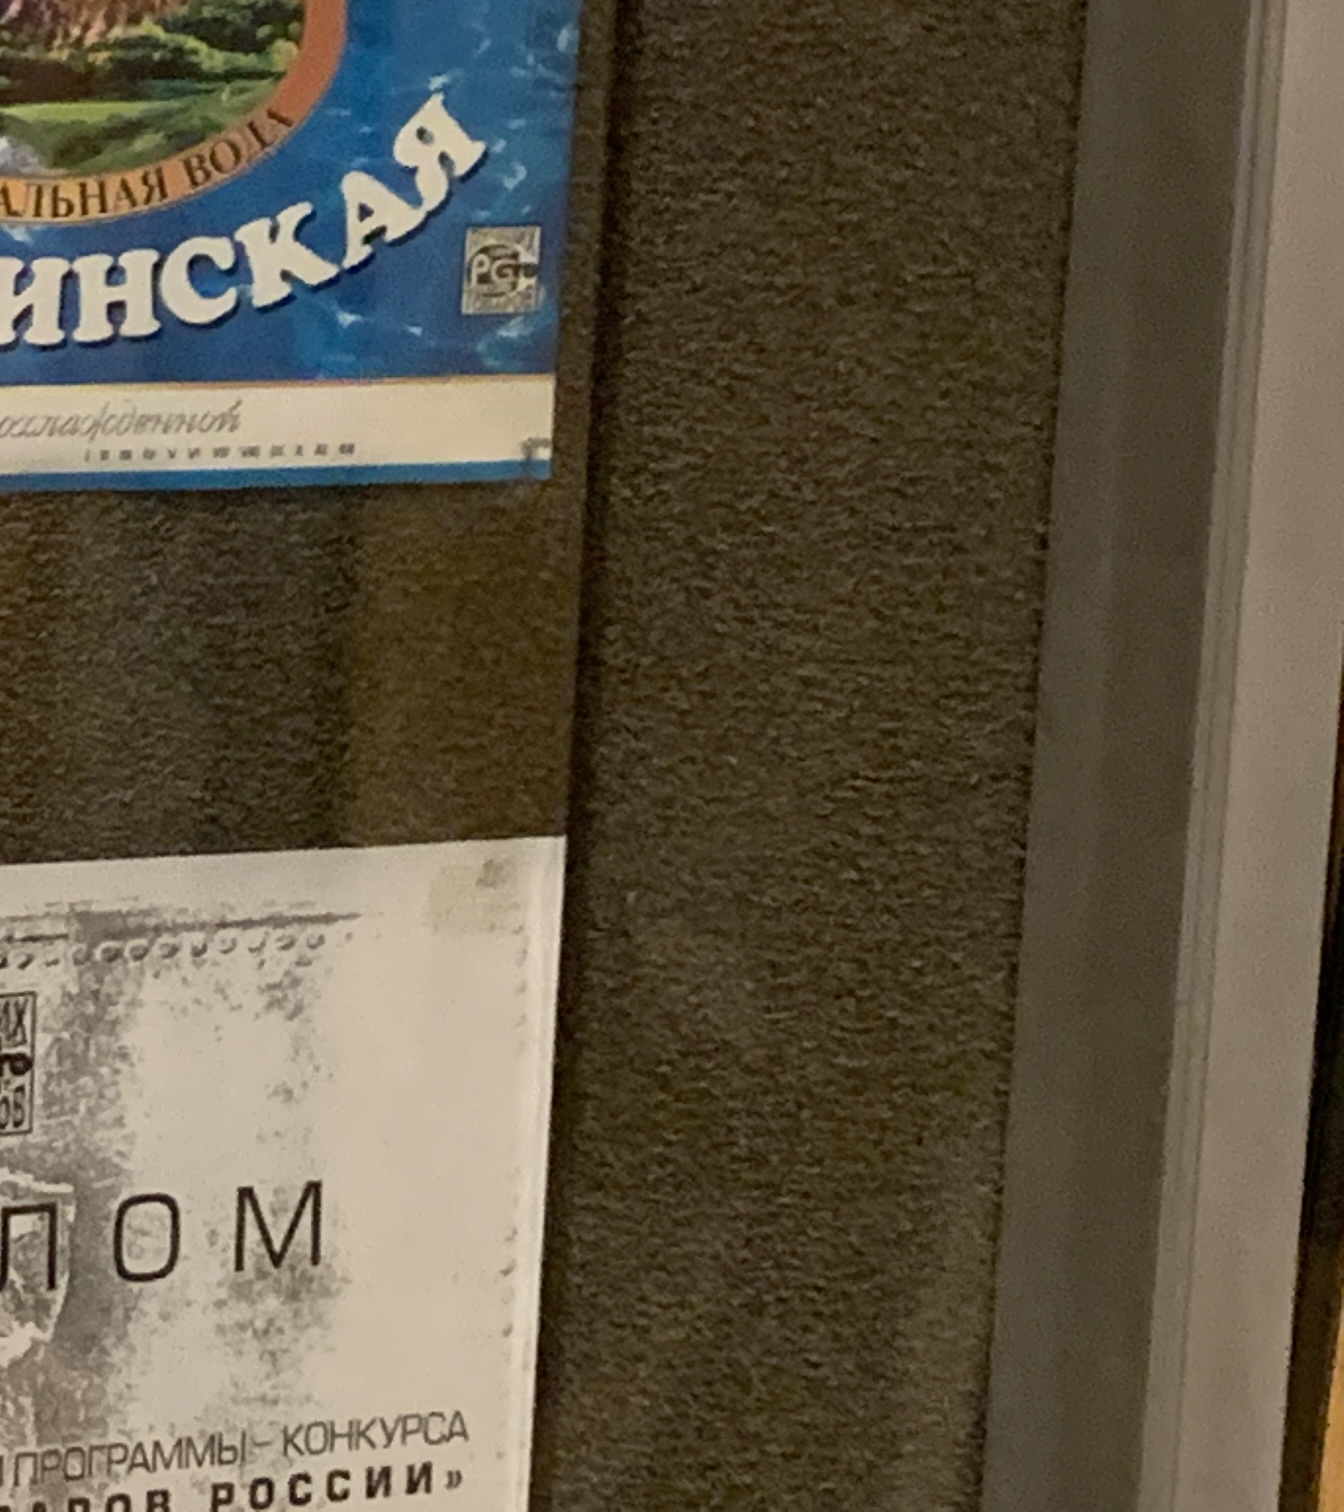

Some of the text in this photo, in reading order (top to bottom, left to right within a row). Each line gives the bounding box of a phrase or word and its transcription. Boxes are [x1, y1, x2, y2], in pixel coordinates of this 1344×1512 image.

[183, 104, 296, 190] ВОДА
[12, 1428, 248, 1486] ПРОГРАММЫ
[279, 1409, 471, 1459] КОНКУРСА
[209, 1460, 465, 1512] РОССИИ»
